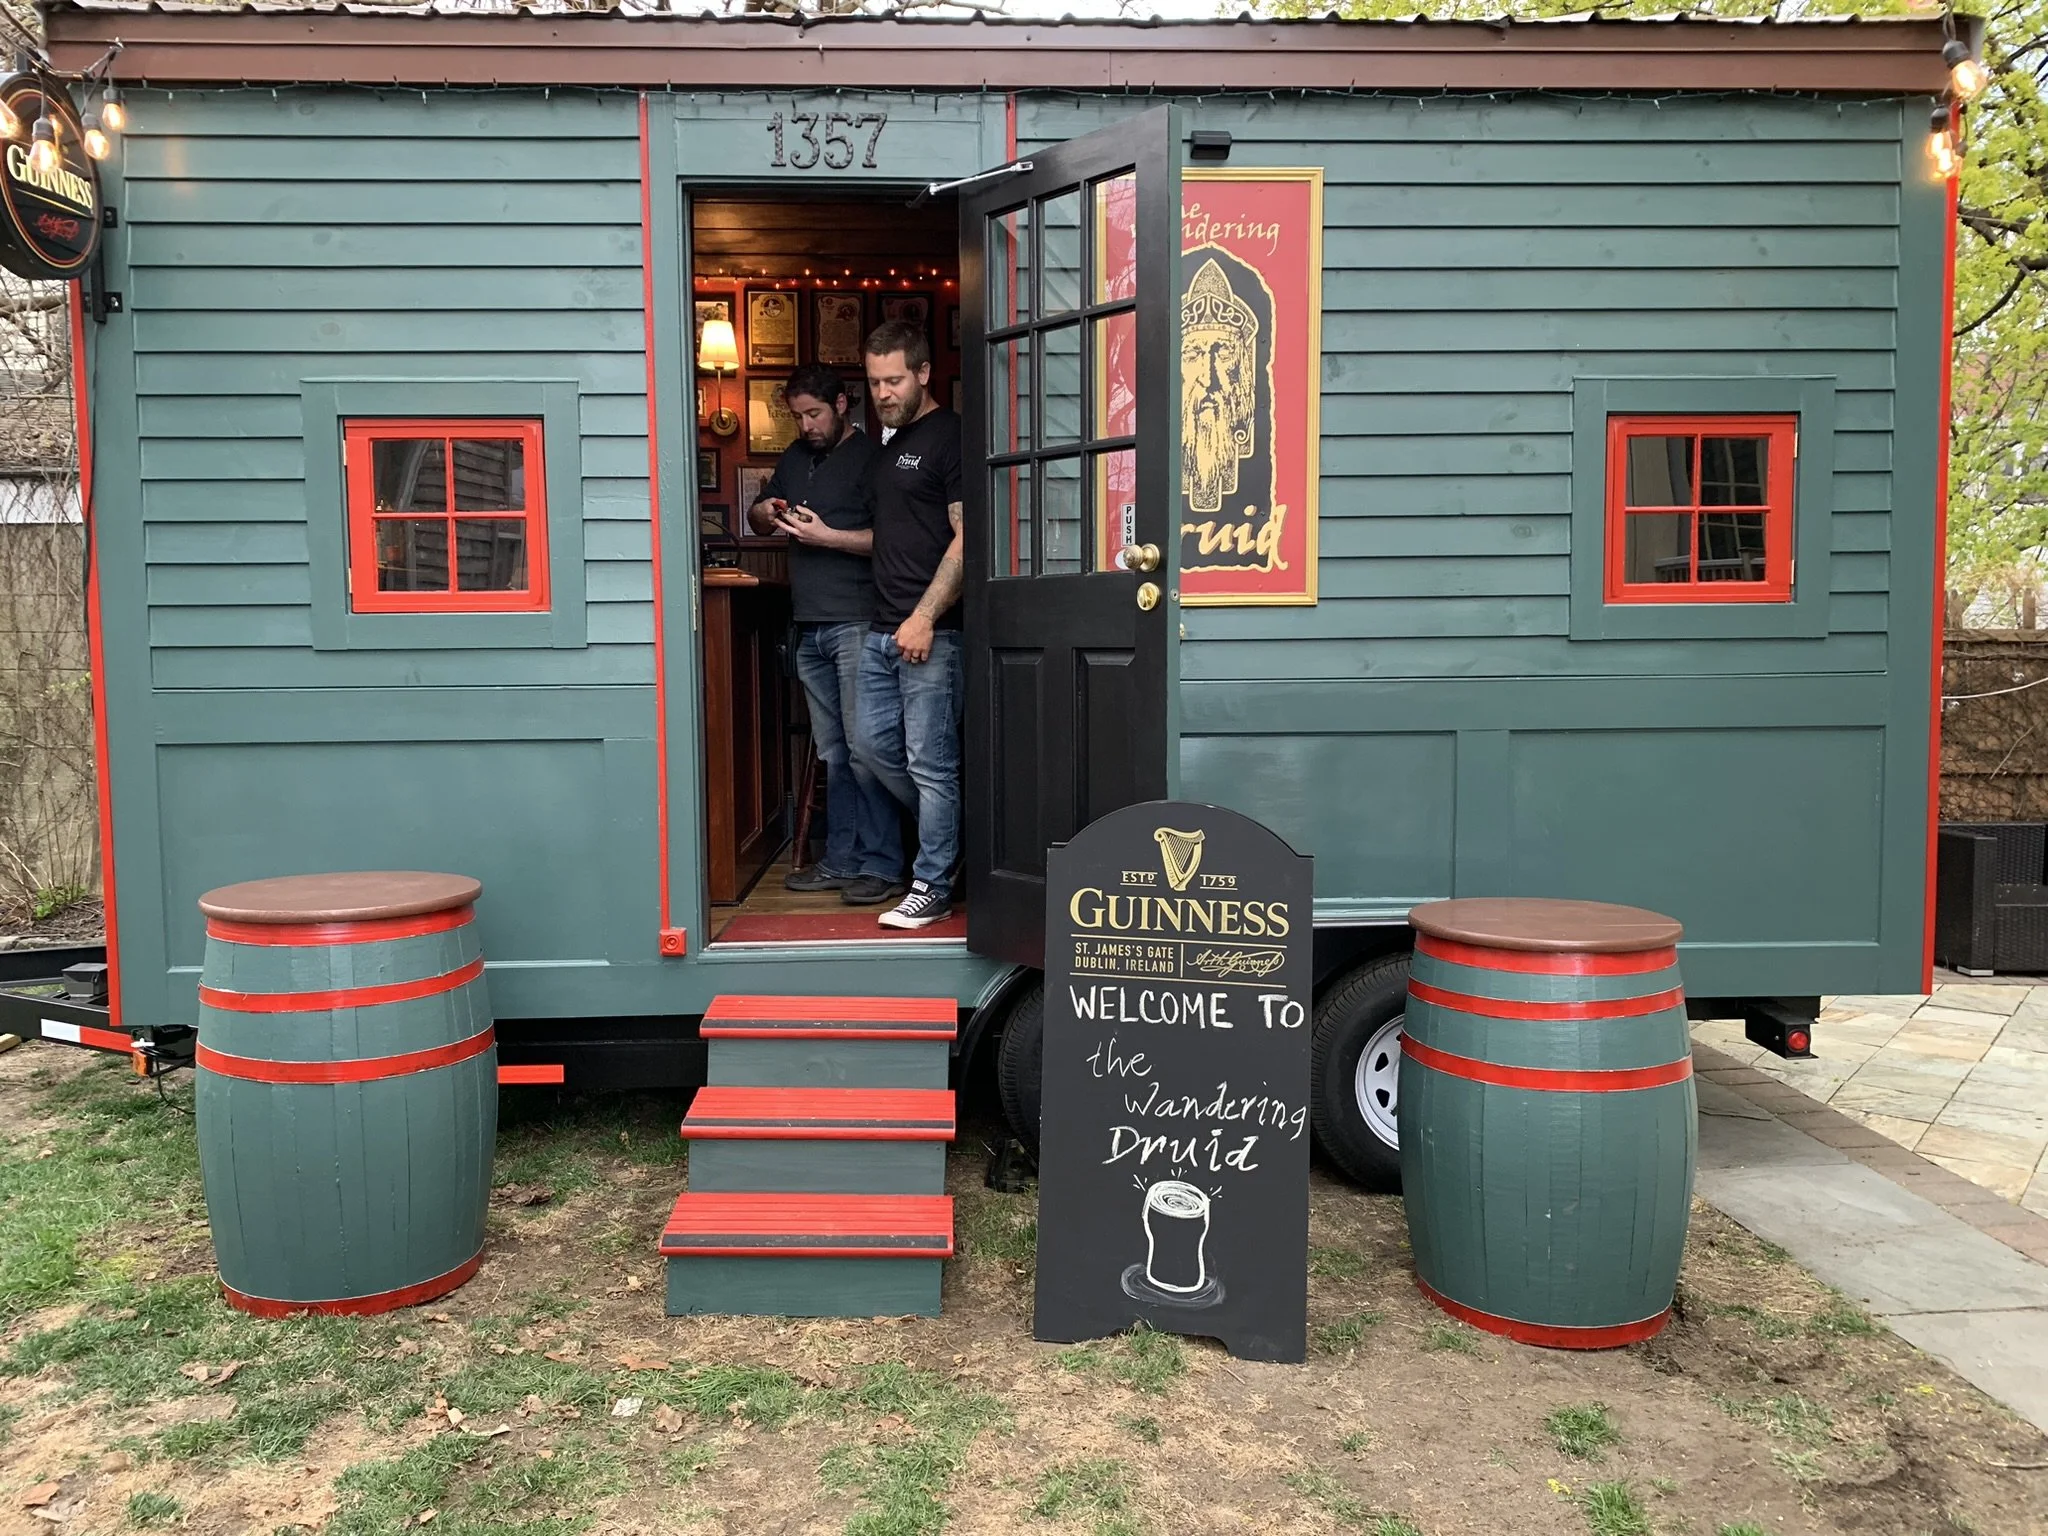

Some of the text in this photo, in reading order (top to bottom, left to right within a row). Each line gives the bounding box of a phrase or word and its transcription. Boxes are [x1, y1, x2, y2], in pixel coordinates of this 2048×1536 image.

[767, 112, 888, 169] 1357
[7, 144, 93, 207] GUINNESS
[1181, 213, 1281, 256] ndering
[1181, 504, 1289, 571] ruid
[1202, 876, 1236, 887] 1759
[1069, 887, 1290, 938] GUINNESS
[1075, 942, 1174, 959] ST. JAMES'S GATE
[1125, 959, 1174, 973] IRELAND
[1069, 985, 1304, 1029] WELCOME TO
[1086, 1037, 1152, 1077] the
[1101, 1125, 1259, 1172] Druid
